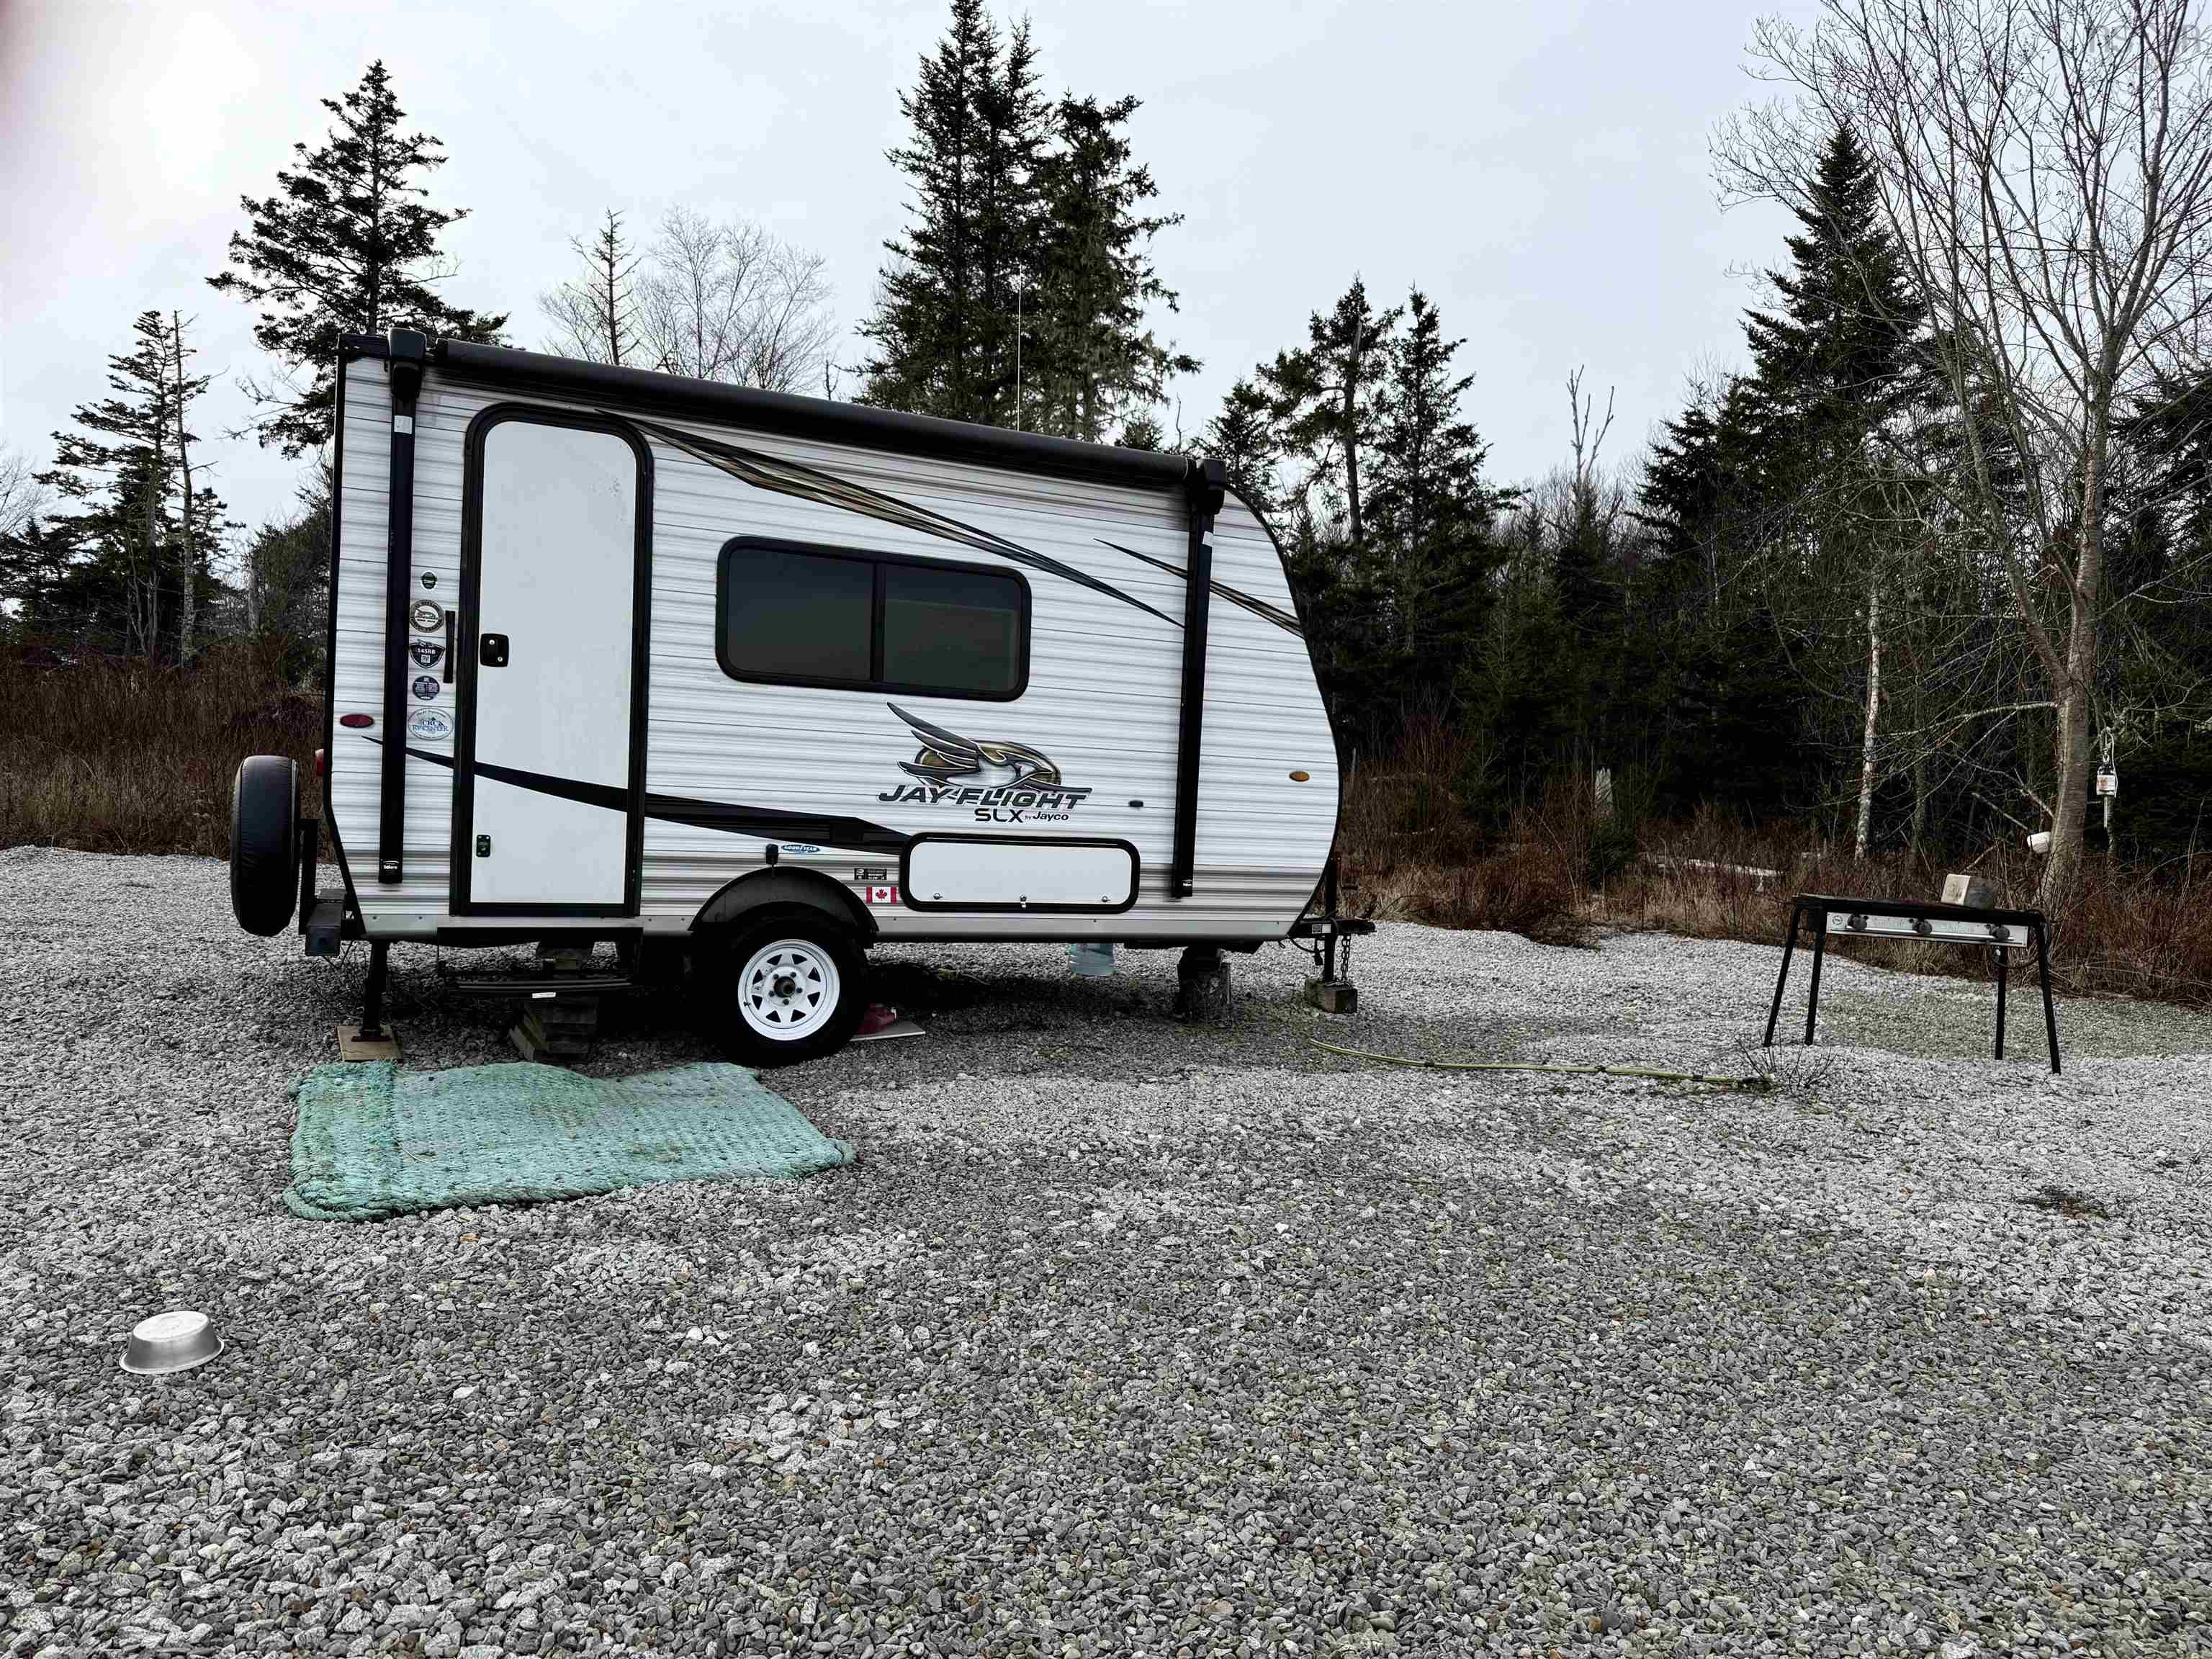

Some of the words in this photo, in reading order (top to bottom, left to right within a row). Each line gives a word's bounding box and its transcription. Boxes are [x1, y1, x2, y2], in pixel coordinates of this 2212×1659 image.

[878, 784, 950, 804] JAY
[956, 788, 1088, 809] FLIGHT
[974, 808, 1024, 823] SLX
[1033, 811, 1069, 822] Jayco
